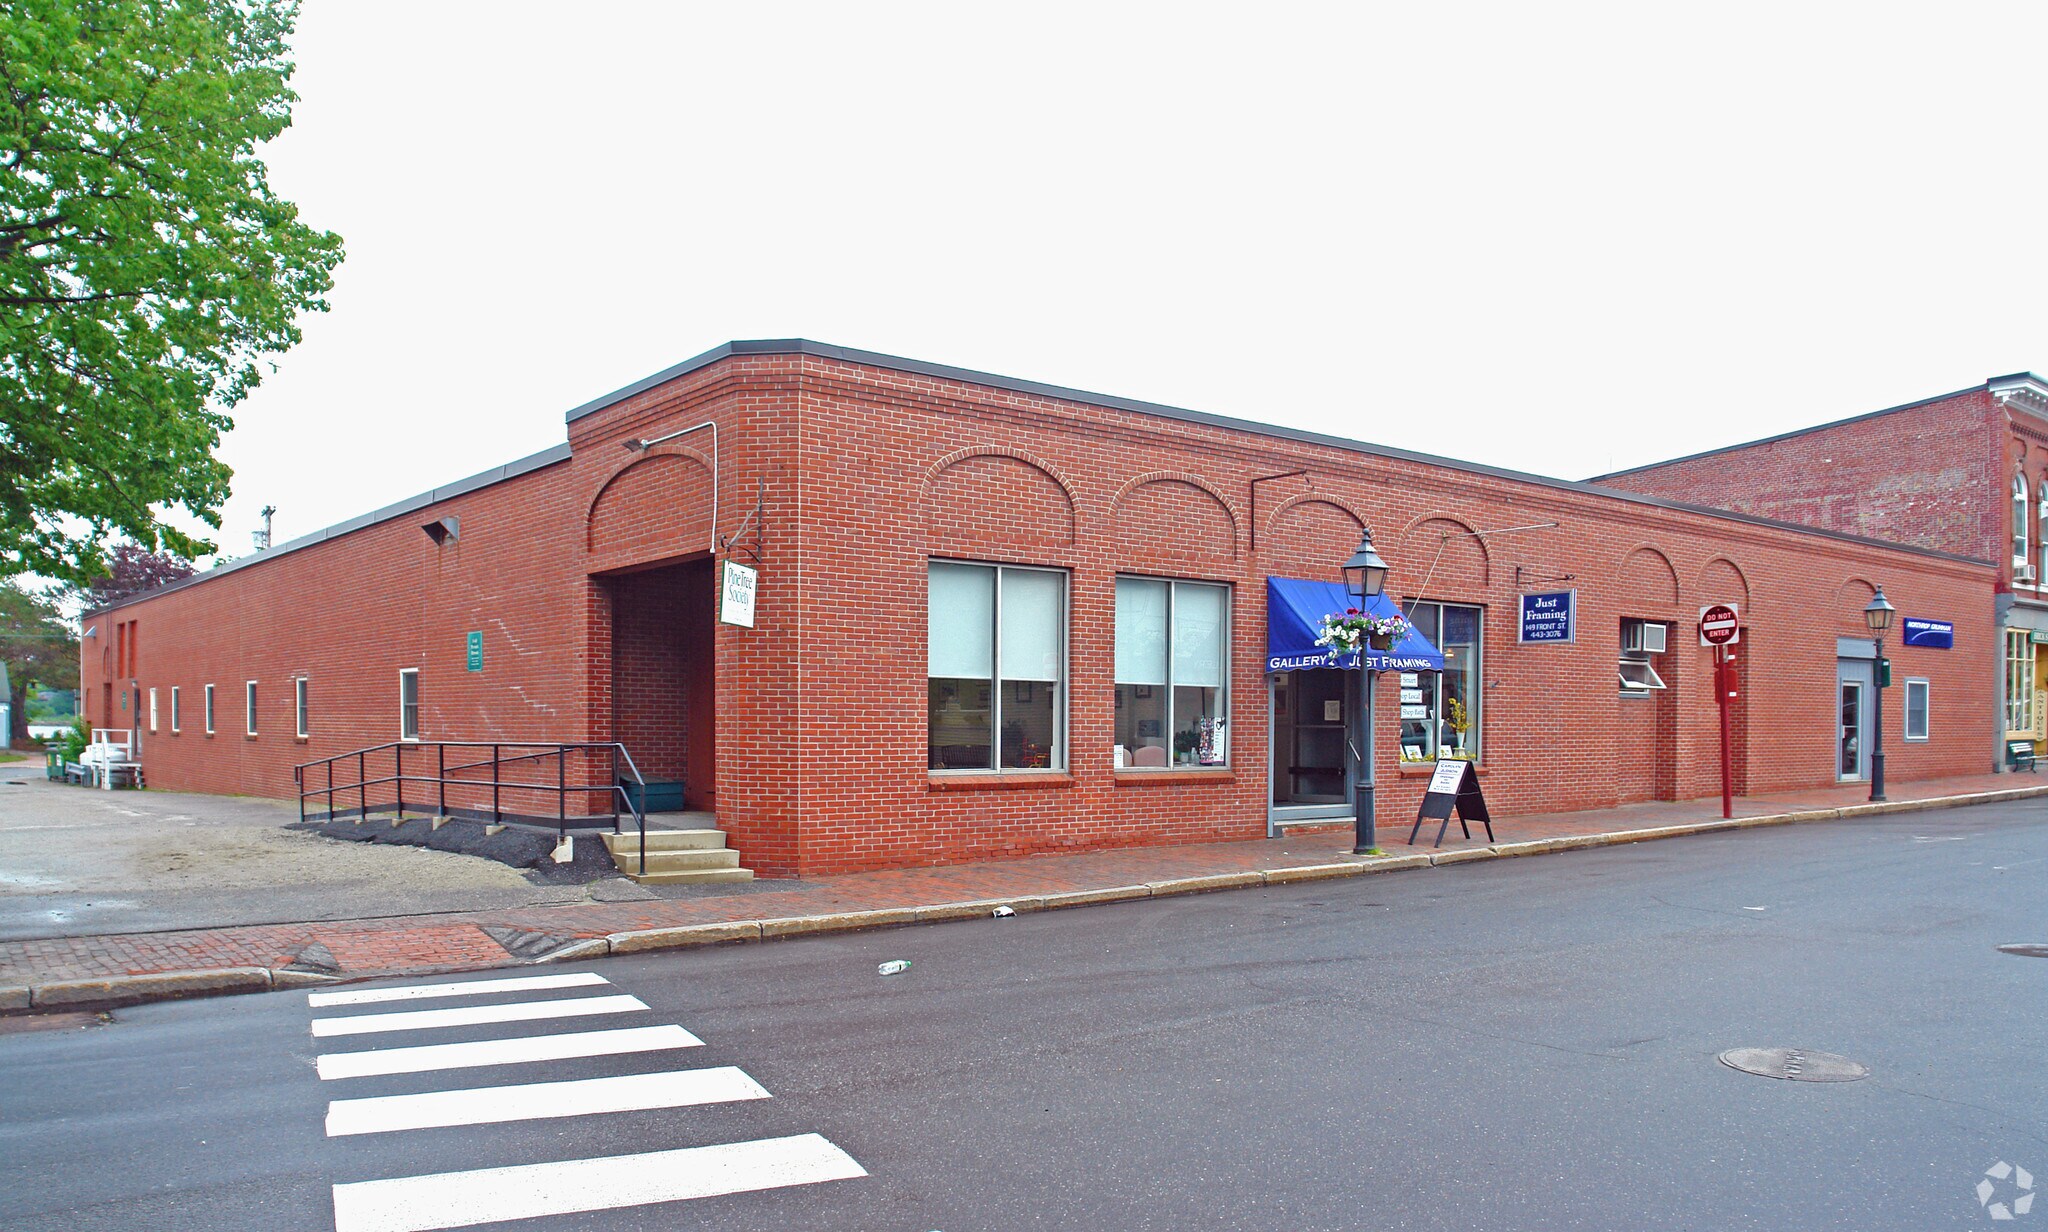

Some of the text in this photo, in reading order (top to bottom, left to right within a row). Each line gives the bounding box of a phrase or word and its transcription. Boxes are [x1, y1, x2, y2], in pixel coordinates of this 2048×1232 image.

[728, 567, 753, 589] Pine Tree
[728, 584, 749, 611] Society
[1535, 597, 1557, 608] Just
[1526, 609, 1567, 622] Framing
[1718, 612, 1731, 620] NOT
[1530, 630, 1562, 638] 443-3076
[1709, 629, 1730, 637] ENTER
[1270, 655, 1327, 669] GALLERY
[1382, 656, 1431, 668] FRAMING
[1402, 709, 1414, 717] Shop
